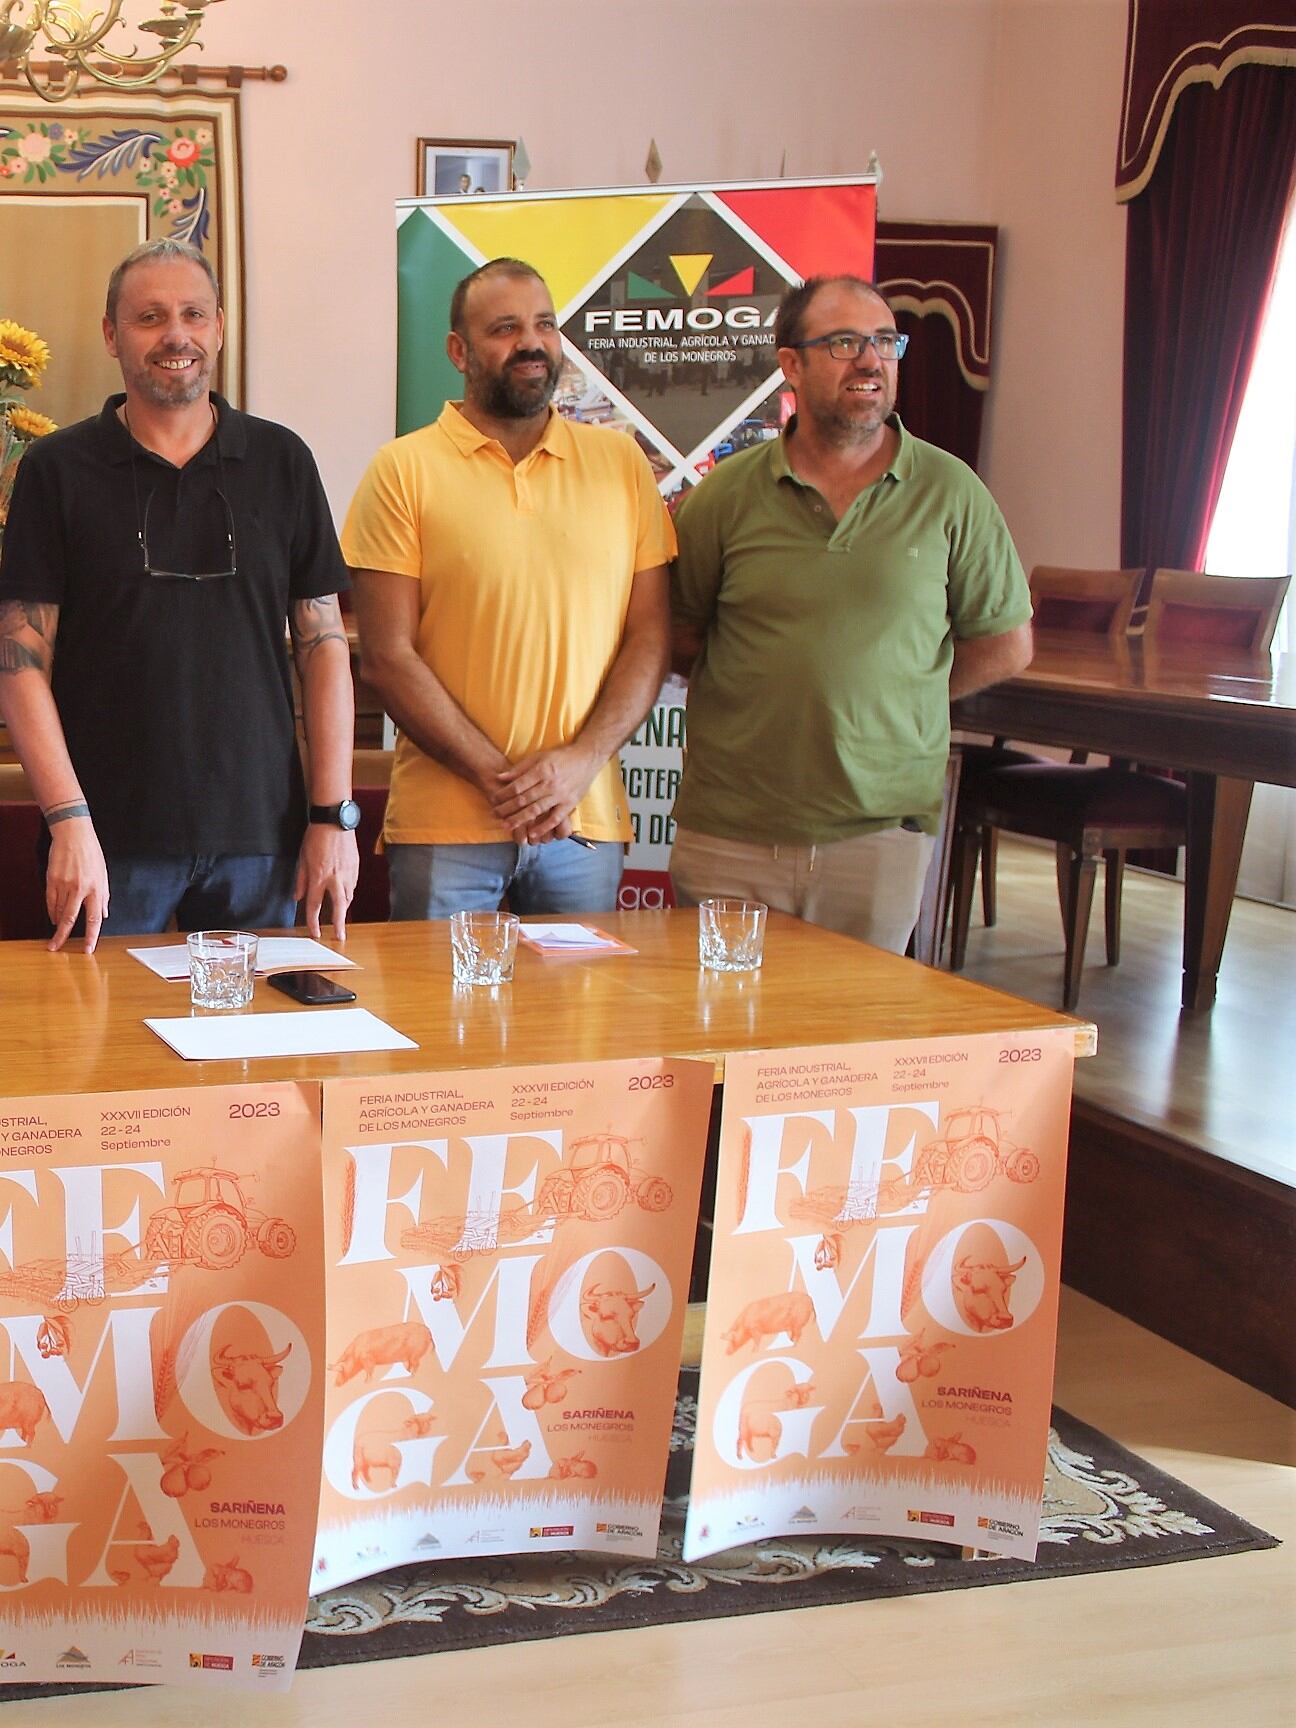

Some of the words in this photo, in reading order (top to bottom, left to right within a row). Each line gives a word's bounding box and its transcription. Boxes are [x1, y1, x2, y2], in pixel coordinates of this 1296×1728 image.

[588, 337, 616, 349] FERIA
[618, 336, 678, 349] INDUSTRIAL,
[681, 333, 729, 347] AGRÍCOLA
[731, 335, 738, 346] Y
[741, 333, 776, 345] GANAD
[644, 351, 657, 363] DE
[660, 351, 679, 363] LOS
[681, 349, 737, 362] MONEGROS
[928, 1052, 968, 1064] EDICIÓN
[998, 1048, 1042, 1063] 2023
[757, 1067, 787, 1077] FERIA
[789, 1062, 851, 1074] INDUSTRIAL,
[511, 1084, 549, 1094] XXXVII
[550, 1079, 595, 1092] EDICIÓN
[628, 1074, 675, 1091] 2023
[756, 1078, 810, 1090] AGRÍCOLA
[812, 1078, 819, 1086] Y
[820, 1072, 878, 1084] GANADERA
[891, 1080, 950, 1092] Septiembre
[360, 1095, 393, 1105] FERIA
[394, 1089, 464, 1103] INDUSTRIAL,
[755, 1094, 769, 1103] DE
[771, 1092, 792, 1102] LOS
[793, 1087, 852, 1100] MONEGROS
[100, 1110, 141, 1122] XXXVII
[143, 1105, 191, 1119] EDICIÓN
[228, 1101, 281, 1119] 2023
[359, 1106, 419, 1119] AGRÍCOLA
[421, 1106, 429, 1114] Y
[430, 1100, 495, 1114] GANADERA
[510, 1108, 574, 1121] Septiembre
[359, 1123, 375, 1132] DE
[376, 1121, 400, 1132] LOS
[401, 1115, 467, 1129] MONEGROS
[1, 1133, 10, 1142] Y
[12, 1128, 83, 1141] GANADERA
[100, 1138, 171, 1151] Septiembre
[937, 1386, 1013, 1403] SARIÑENA
[562, 1407, 635, 1420] SARIÑENA
[921, 1399, 943, 1408] LOS
[945, 1400, 1012, 1416] MONEGROS
[547, 1423, 568, 1432] LOS
[570, 1422, 634, 1432] MONEGROS
[210, 1500, 286, 1515] SARIÑENA
[195, 1518, 220, 1528] LOS
[220, 1519, 285, 1530] MONEGROS
